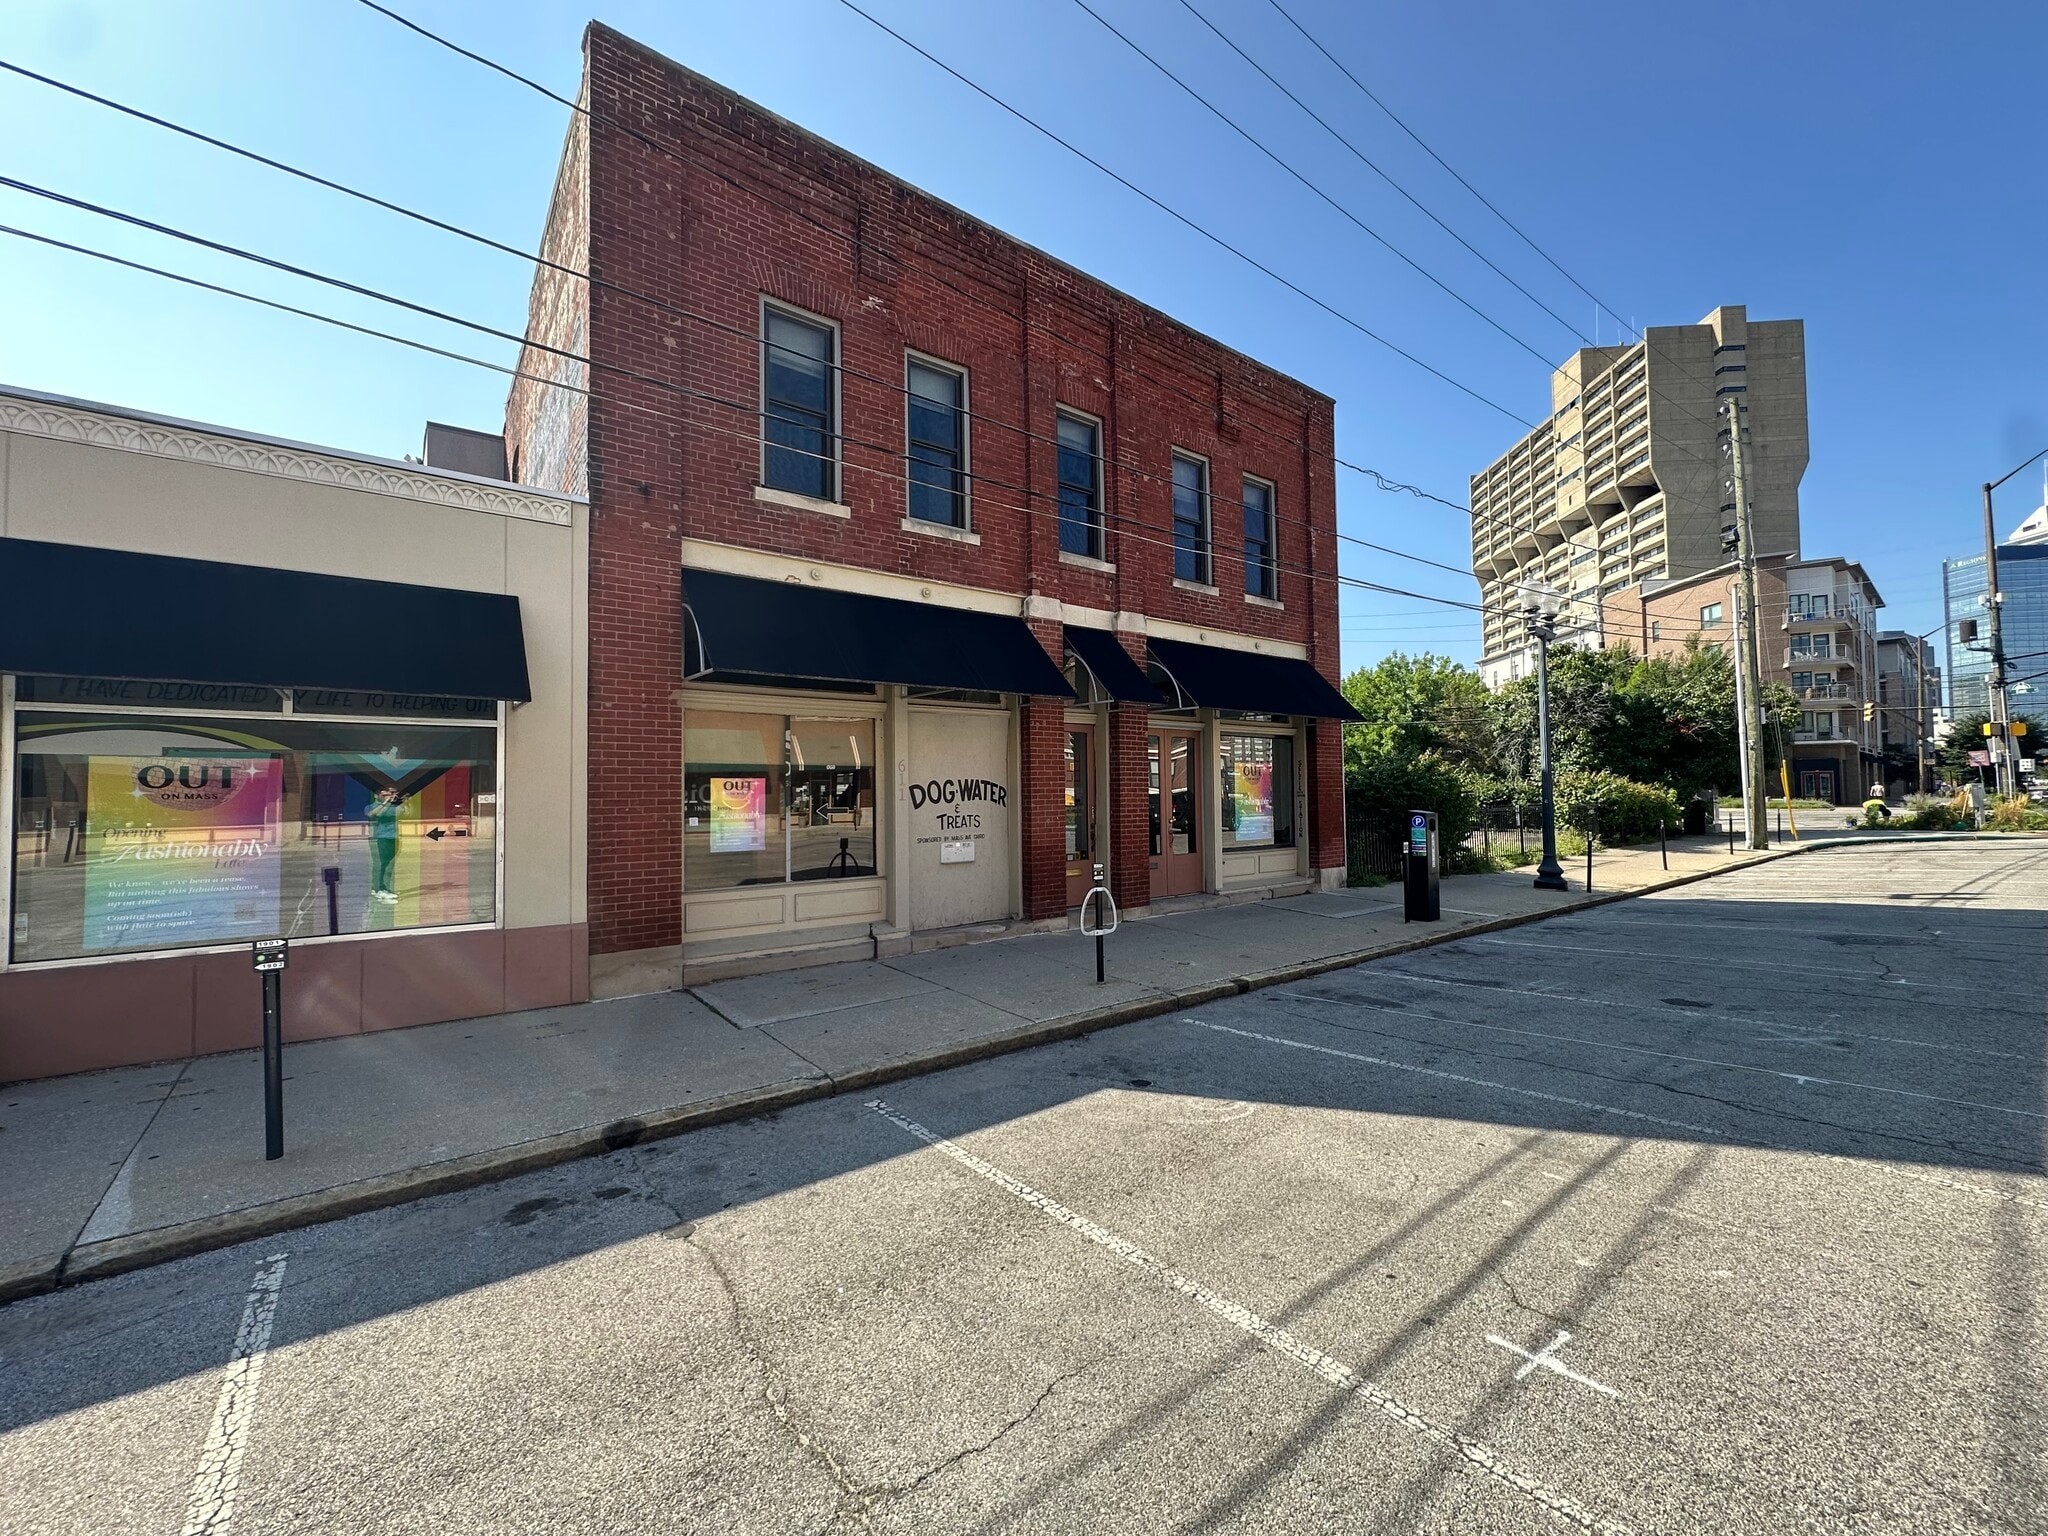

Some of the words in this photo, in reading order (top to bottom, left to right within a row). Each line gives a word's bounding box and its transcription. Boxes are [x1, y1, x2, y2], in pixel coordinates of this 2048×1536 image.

[74, 679, 136, 699] HAVE
[146, 682, 268, 704] DEDICATED
[315, 690, 355, 706] LIFE
[365, 693, 388, 708] TO
[392, 697, 458, 712] HELPING
[137, 765, 241, 789] OUT
[898, 760, 906, 801] 611
[723, 780, 751, 791] OUT
[936, 813, 981, 830] TREATS
[1415, 817, 1422, 826] P
[103, 827, 168, 841] Opening
[102, 838, 268, 864] Fashionably
[108, 881, 125, 889] We
[127, 888, 166, 897] nothing
[188, 885, 229, 894] fabulous
[107, 901, 122, 909] up
[107, 914, 147, 923] Coming
[107, 923, 129, 931] with
[130, 922, 155, 931] flair
